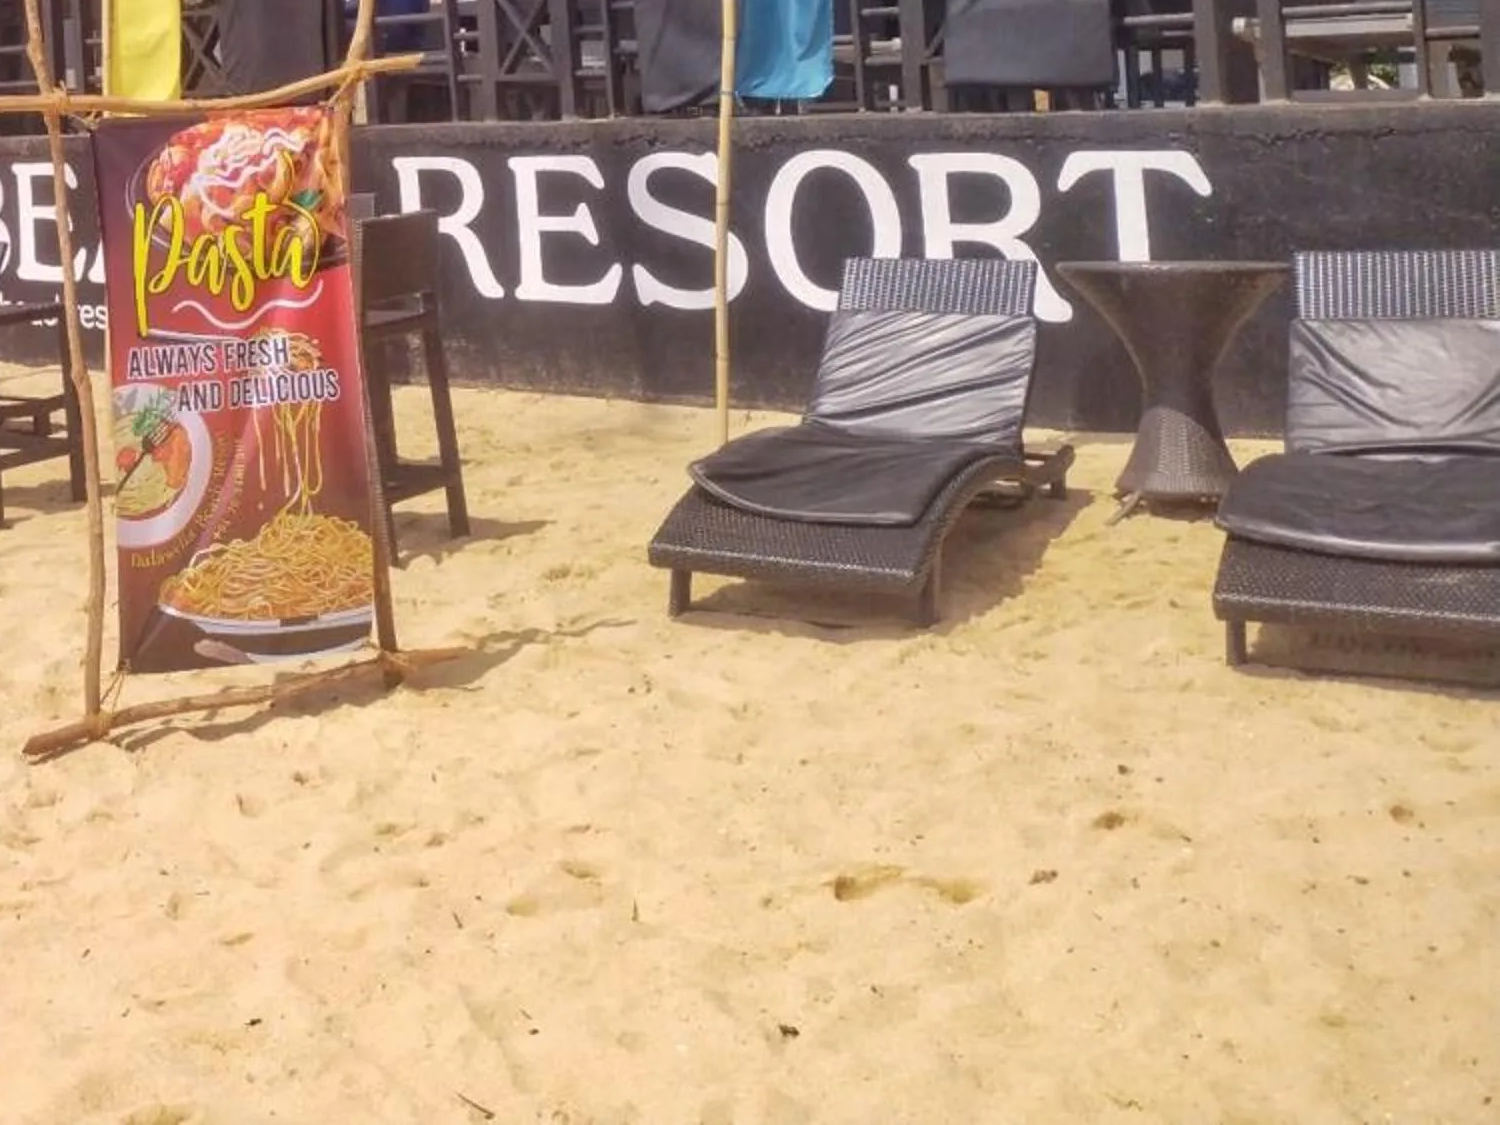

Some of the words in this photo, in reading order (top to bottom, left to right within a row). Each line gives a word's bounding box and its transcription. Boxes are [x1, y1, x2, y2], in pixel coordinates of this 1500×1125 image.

[132, 189, 321, 338] Pasta
[392, 150, 1213, 323] RESORT
[127, 340, 216, 380] ALWAYS
[222, 334, 291, 373] FRESH
[177, 381, 223, 413] AND
[230, 369, 340, 410] DELICIOUS
